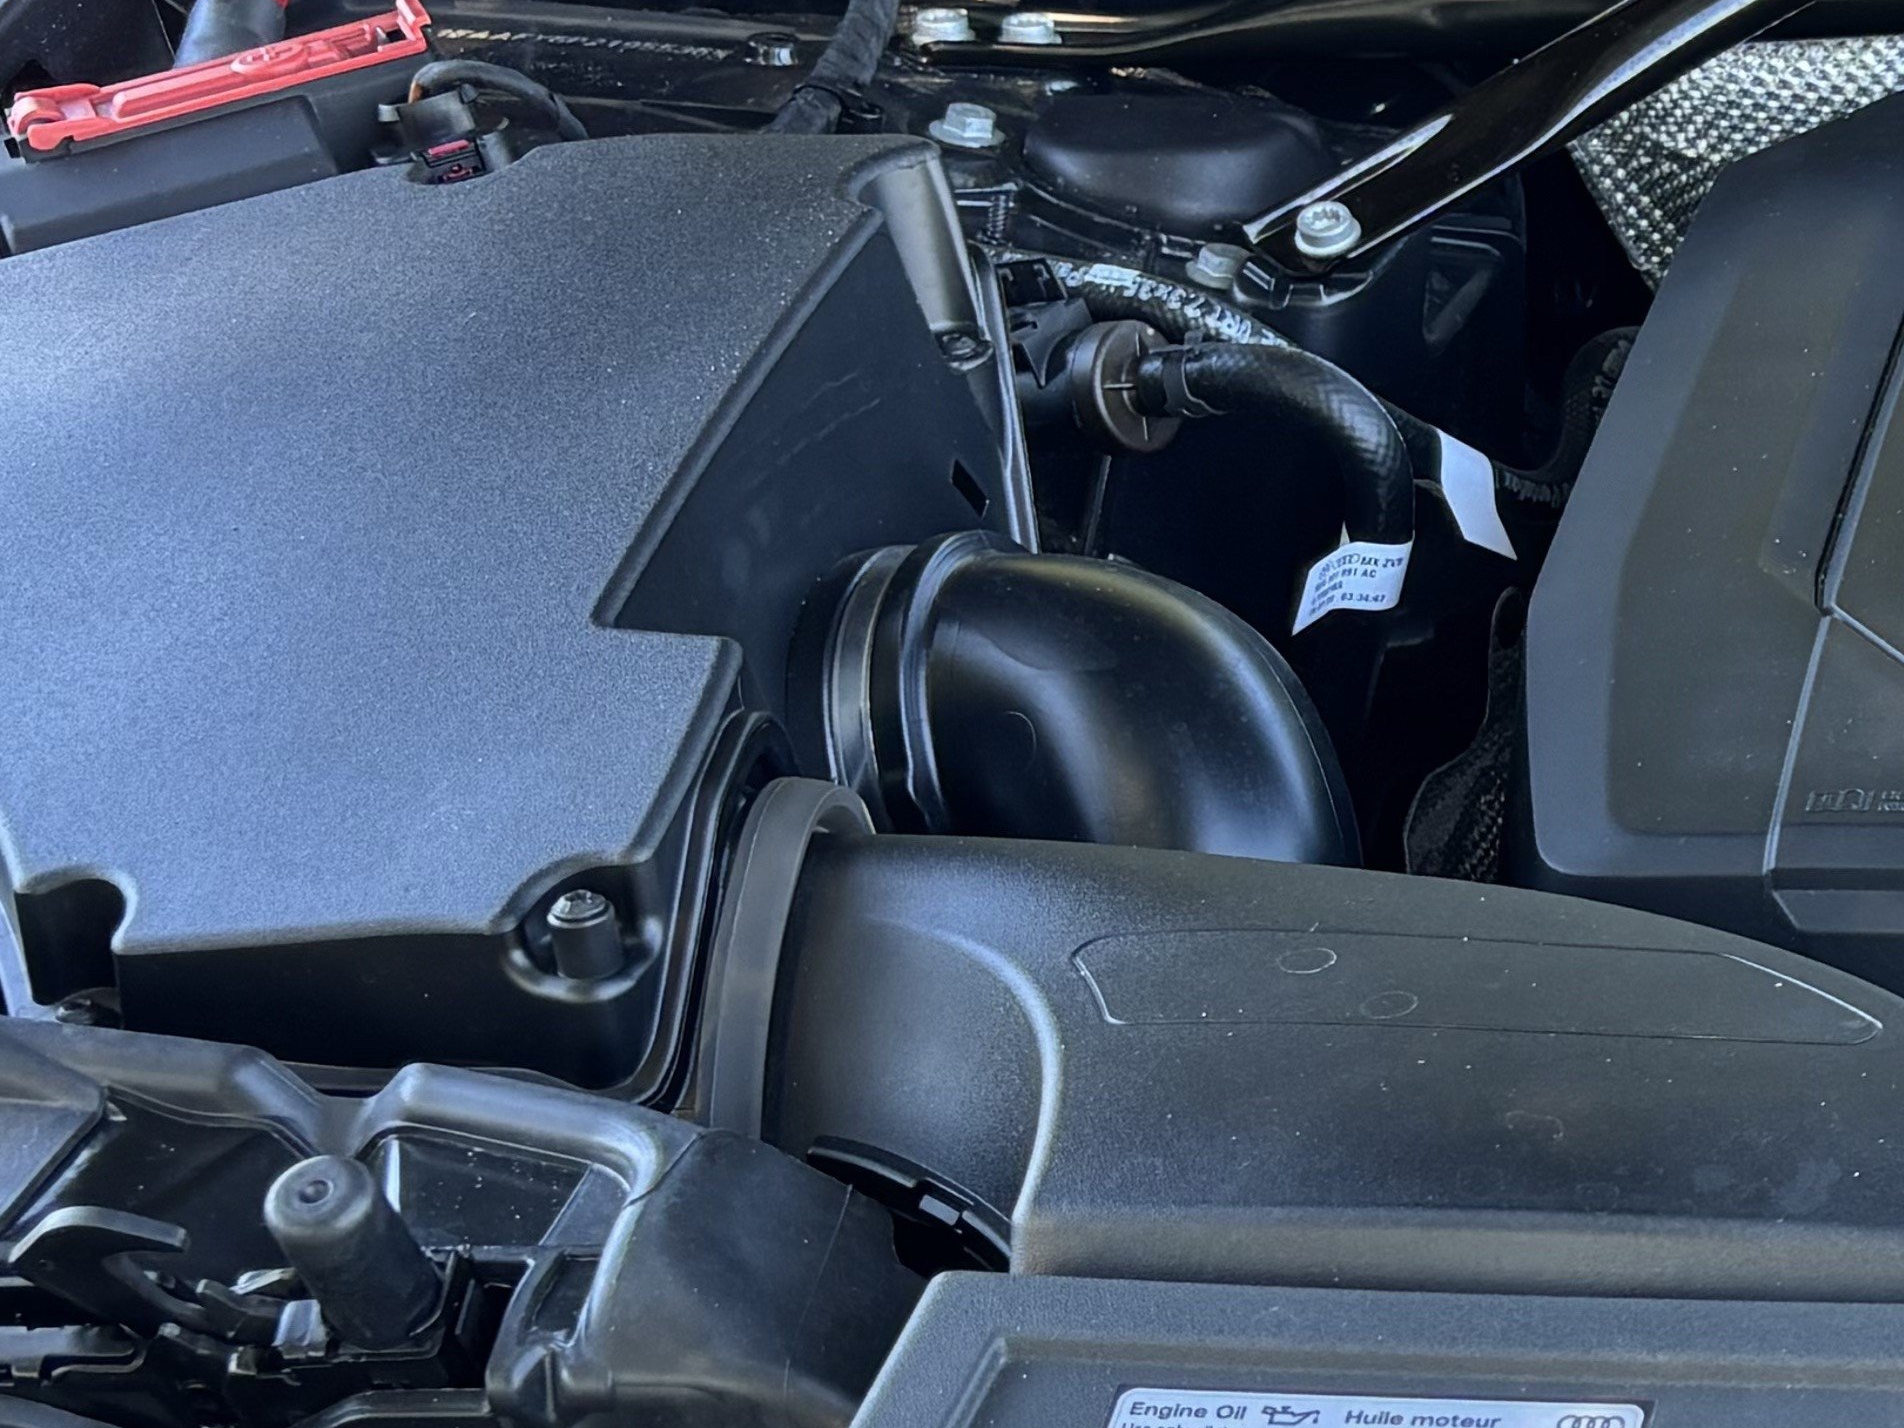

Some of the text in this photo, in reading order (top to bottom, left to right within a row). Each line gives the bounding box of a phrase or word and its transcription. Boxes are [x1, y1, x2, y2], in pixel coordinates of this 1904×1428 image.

[1129, 1401, 1248, 1420] Engine Oil
[1345, 1410, 1502, 1428] Huile moteur
